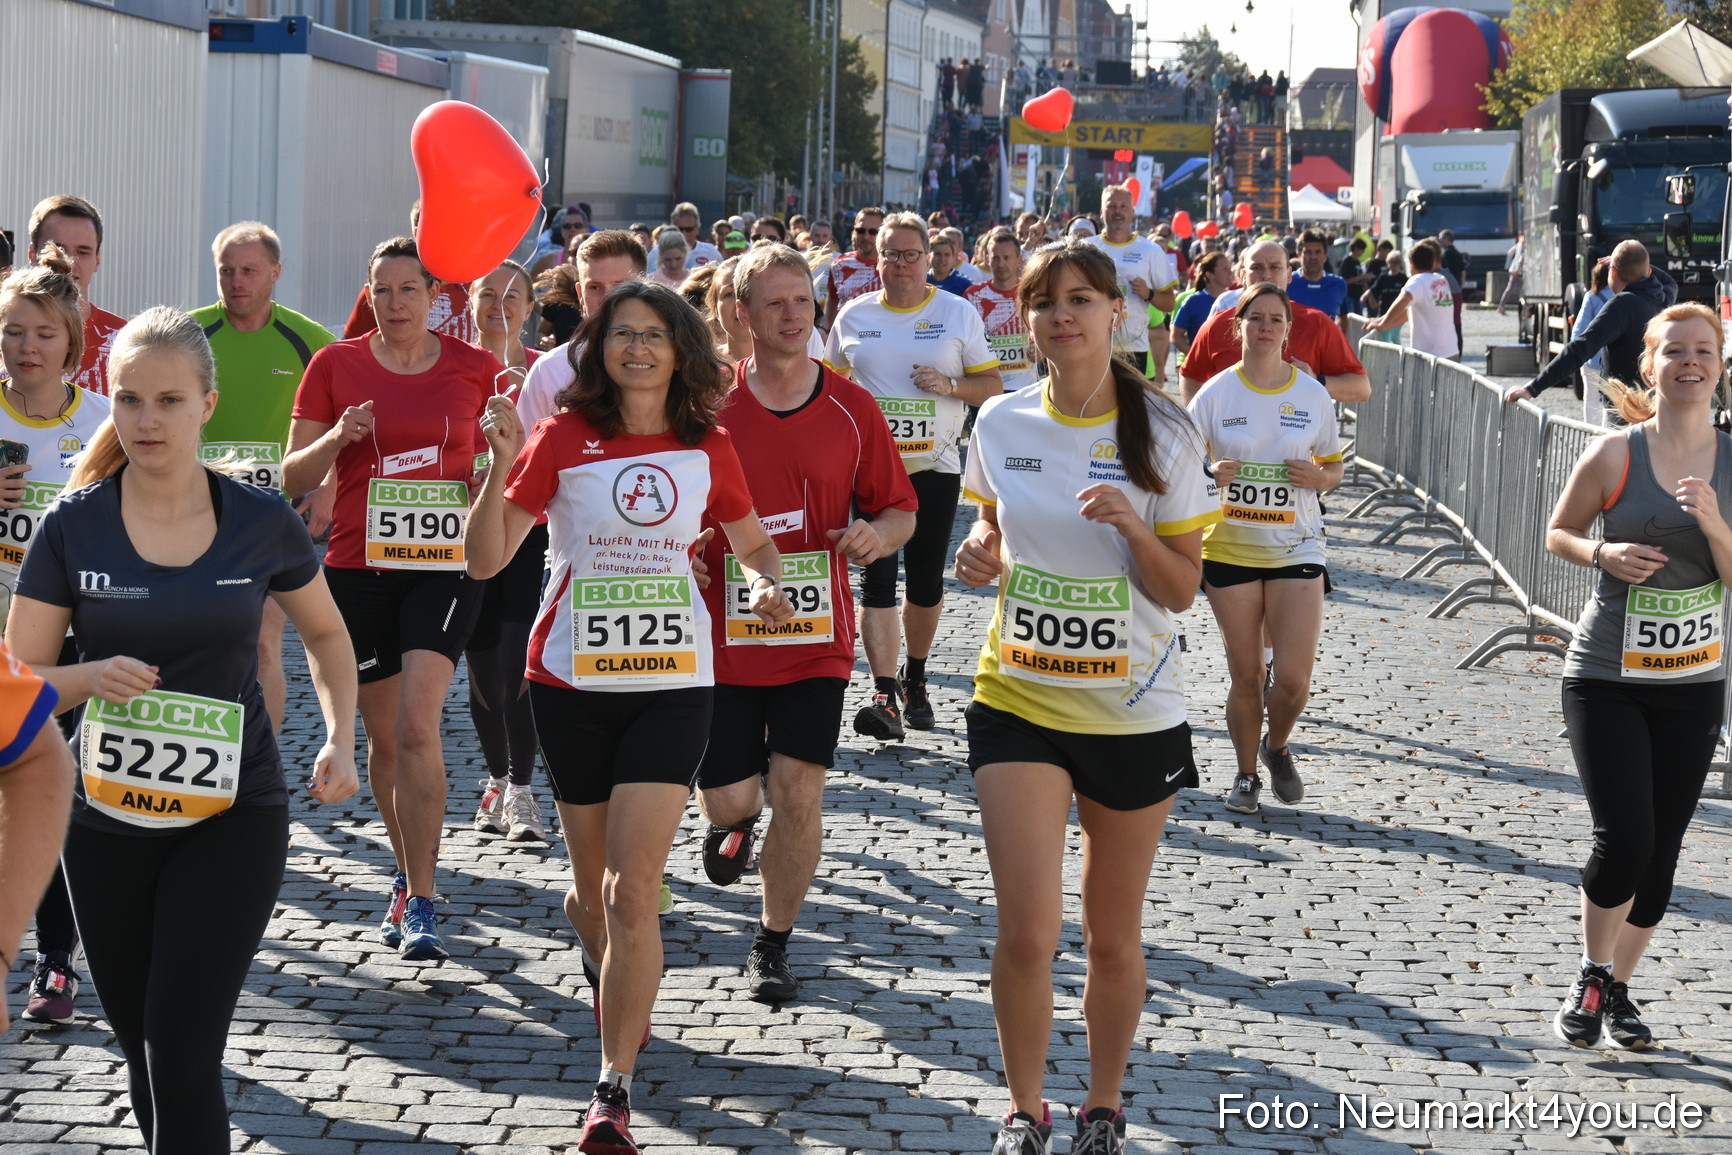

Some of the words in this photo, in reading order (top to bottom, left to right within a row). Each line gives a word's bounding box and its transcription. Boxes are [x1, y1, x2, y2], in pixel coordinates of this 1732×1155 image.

[1076, 126, 1145, 144] START
[693, 136, 726, 158] BO
[995, 349, 1024, 361] 201
[878, 400, 931, 415] BOCK
[1281, 405, 1295, 415] 20
[888, 419, 927, 437] 231
[1280, 422, 1306, 430] Stadtlauf
[60, 439, 80, 451] 20
[898, 443, 928, 451] HARD
[1092, 443, 1116, 459] 20
[398, 454, 423, 467] DEHN
[1005, 457, 1041, 468] BOCK
[376, 483, 462, 504] BOCK
[1228, 483, 1289, 506] 5019
[1228, 508, 1285, 521] JOHANNA
[379, 511, 460, 539] 5190
[384, 546, 453, 560] MELANIE
[638, 538, 660, 549] MIT
[664, 538, 689, 551] HER
[610, 550, 631, 560] Heck
[640, 553, 650, 561] Dr.
[582, 580, 684, 605] BOCK
[1014, 569, 1120, 607] BOCK
[1635, 584, 1716, 615] BOCK
[587, 613, 683, 647] 5125
[745, 622, 813, 635] THOMAS
[1013, 607, 1116, 650] 5096
[1637, 613, 1712, 649] 5025
[595, 657, 677, 672] CLAUDIA
[1012, 650, 1116, 674] ELISABETH
[1642, 650, 1709, 669] SABRINA
[1145, 649, 1170, 689] September
[98, 696, 229, 737] BOCK
[97, 732, 219, 788] 5222
[226, 754, 233, 762] S
[121, 791, 183, 813] ANJA
